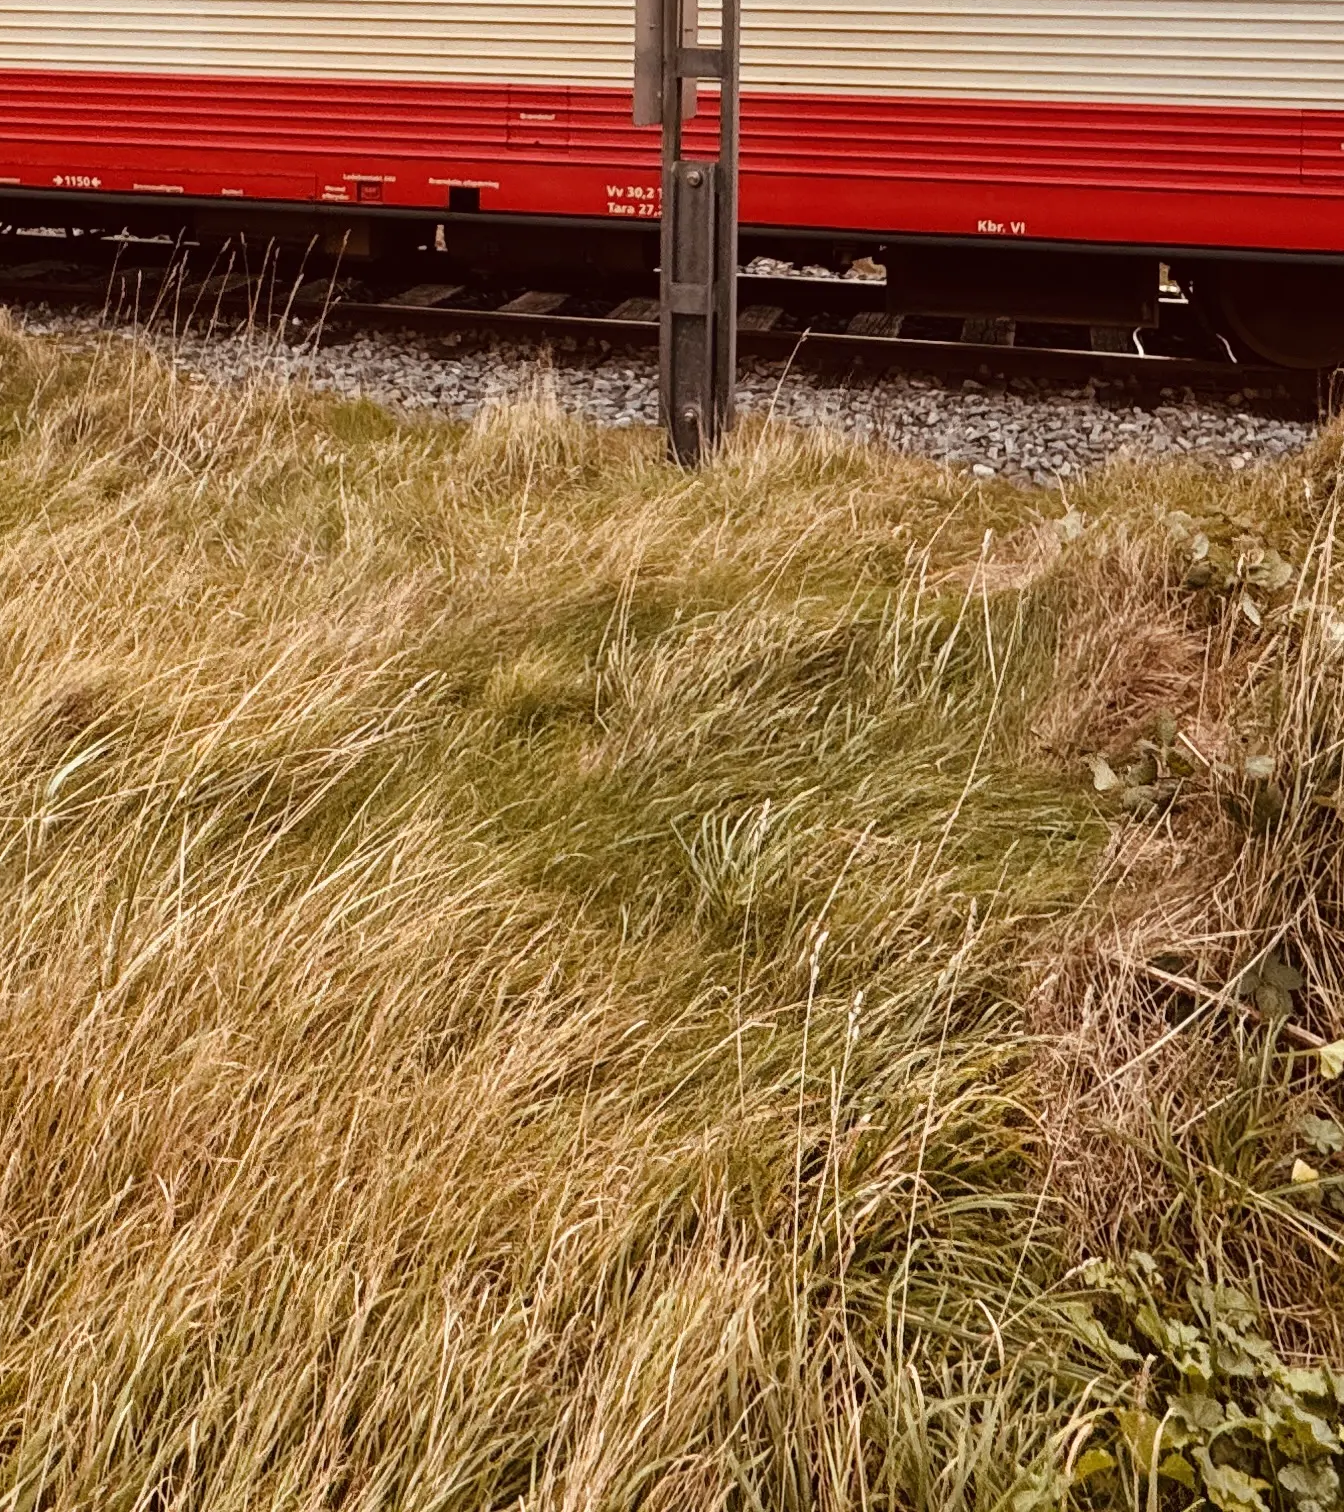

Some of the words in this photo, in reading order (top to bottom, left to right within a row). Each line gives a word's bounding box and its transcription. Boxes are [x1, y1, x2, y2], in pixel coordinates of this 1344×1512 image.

[64, 175, 91, 187] 1150
[606, 185, 624, 198] Vv
[627, 186, 655, 200] 30,2
[607, 201, 635, 215] Tara
[977, 219, 1006, 234] Kbr.
[1010, 221, 1026, 235] VI
